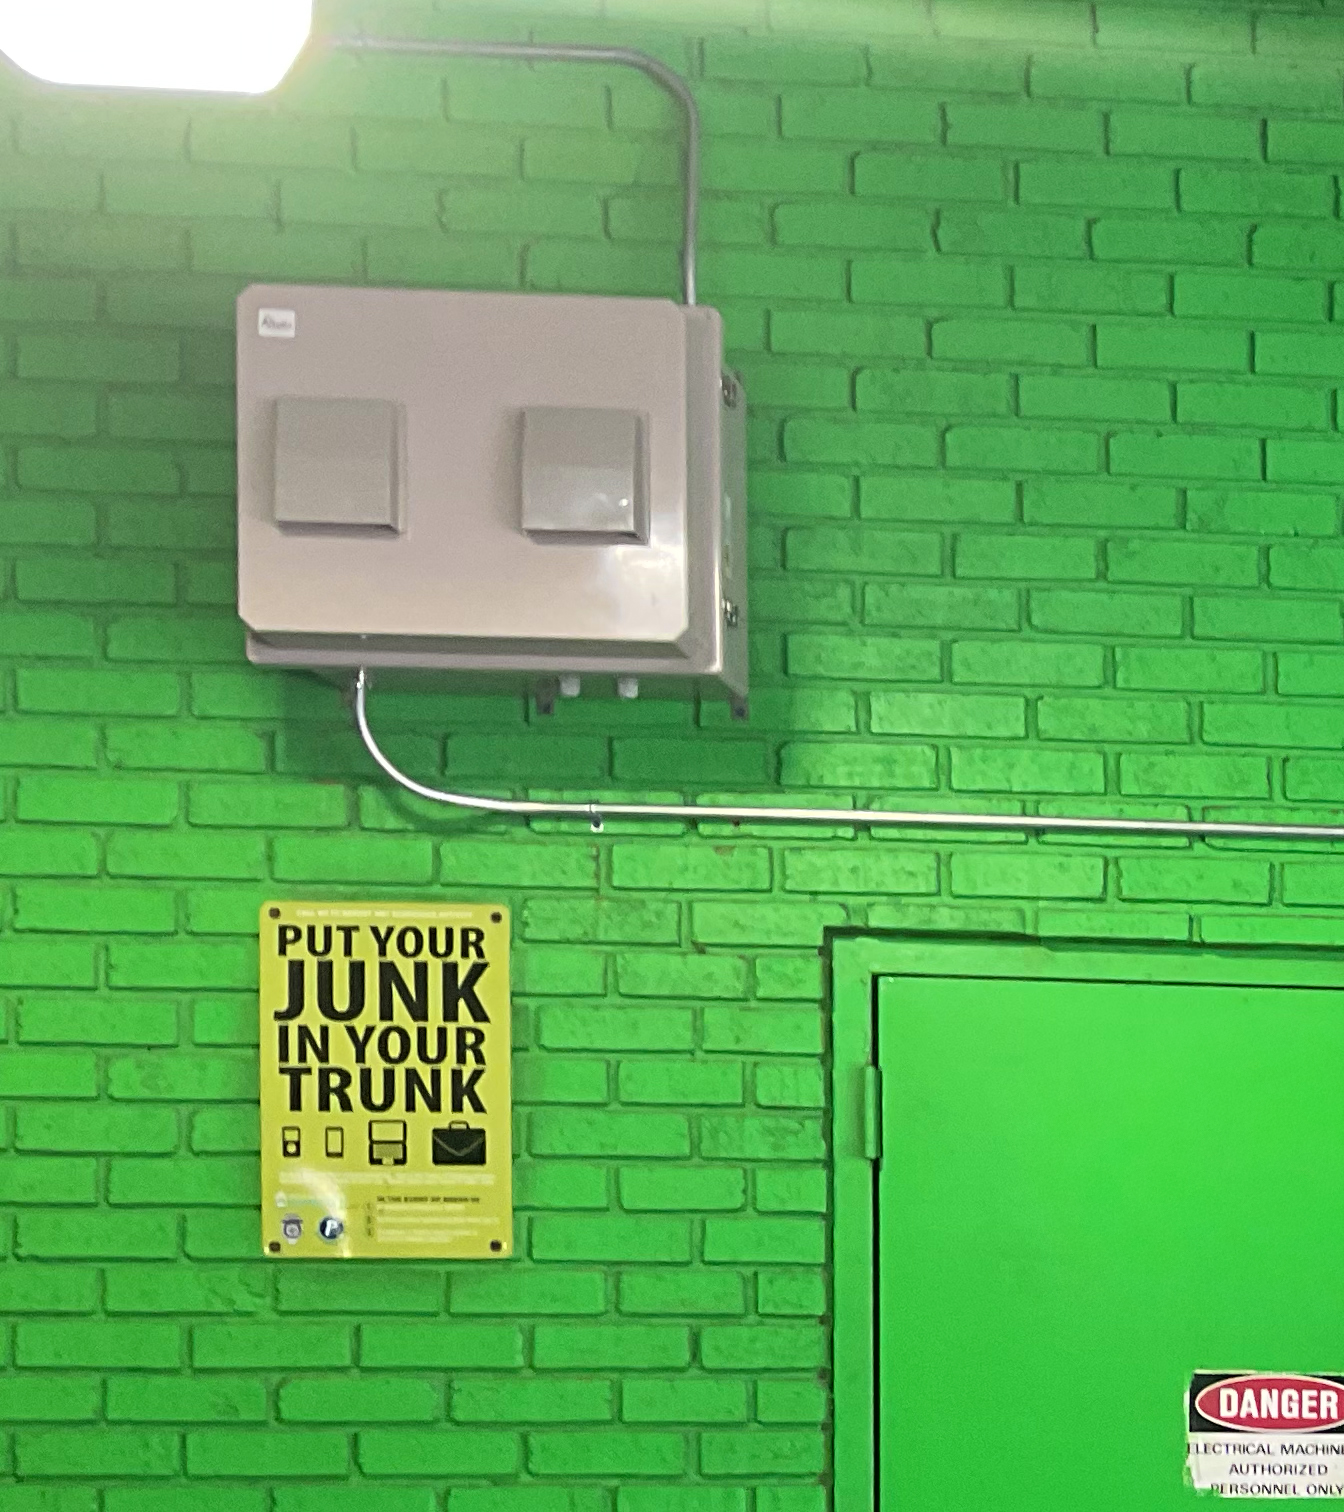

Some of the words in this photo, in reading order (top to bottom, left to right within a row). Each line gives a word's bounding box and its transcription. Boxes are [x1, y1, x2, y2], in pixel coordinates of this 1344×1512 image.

[277, 924, 360, 958] PUT
[370, 925, 486, 960] YOUR
[273, 959, 492, 1024] JUNK
[278, 1025, 330, 1064] IN
[344, 1025, 487, 1066] YOUR
[278, 1066, 488, 1114] TRUNK
[1218, 1387, 1339, 1420] DANGER
[1187, 1442, 1274, 1456] ELECTRICAL
[1228, 1463, 1328, 1477] AUTHORIZED
[1306, 1484, 1344, 1496] ONLY
